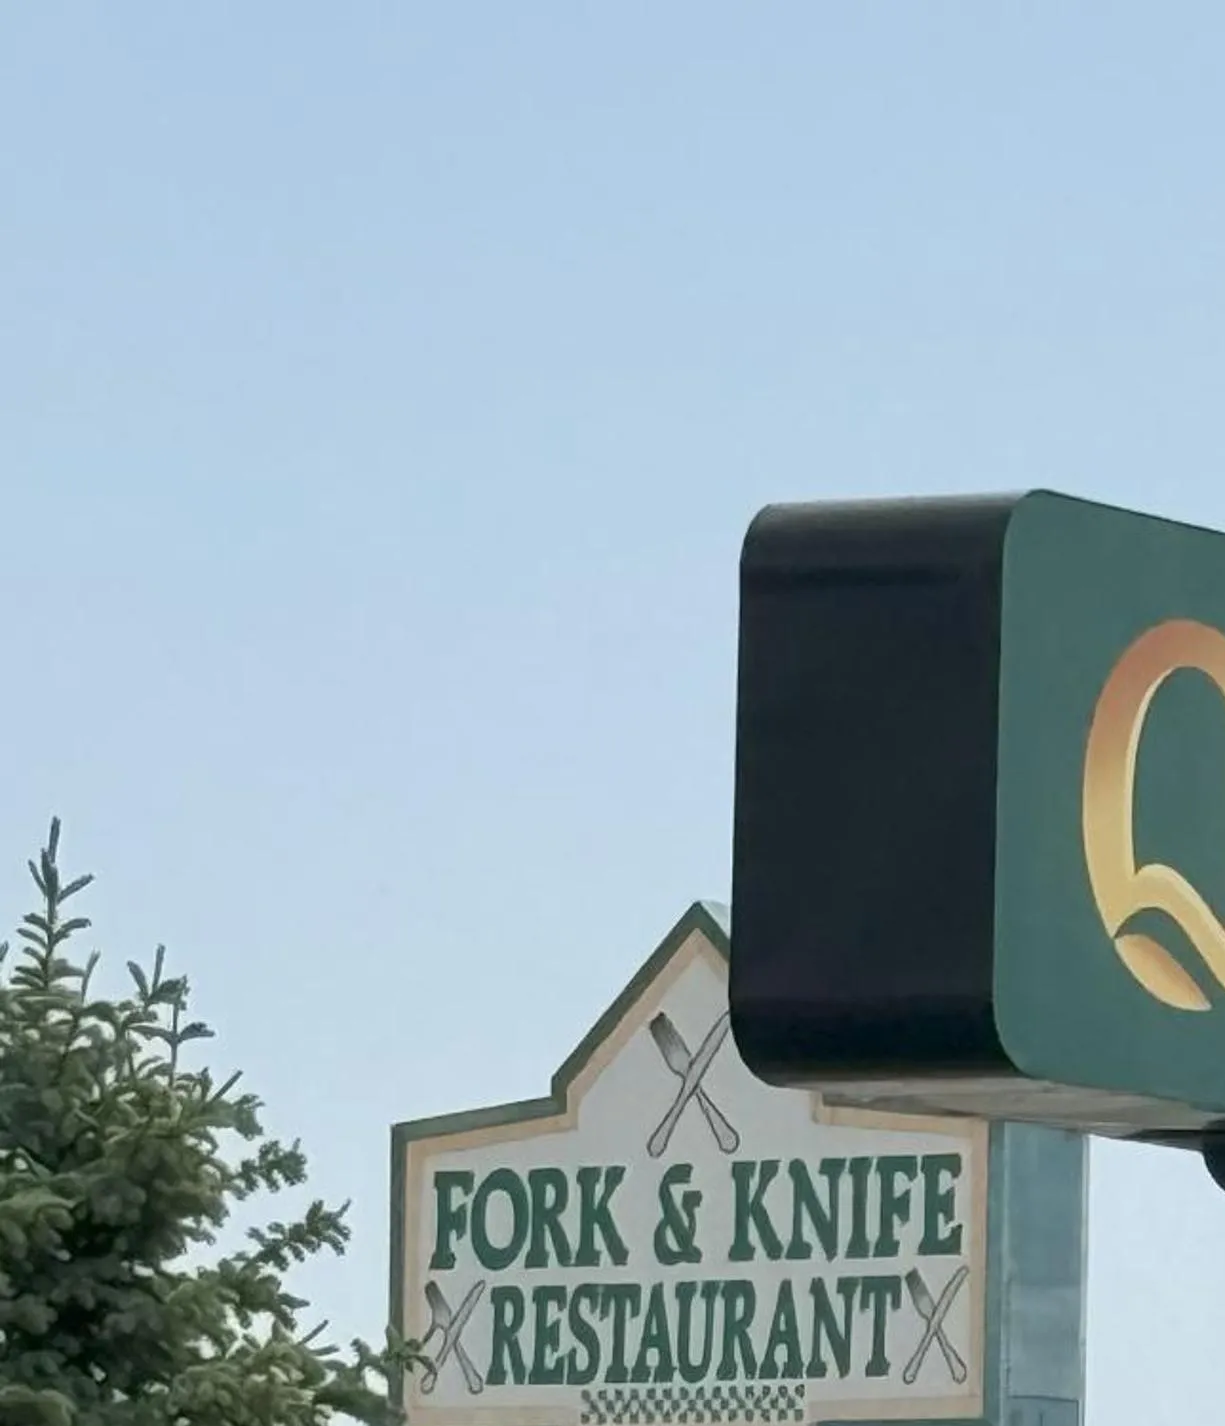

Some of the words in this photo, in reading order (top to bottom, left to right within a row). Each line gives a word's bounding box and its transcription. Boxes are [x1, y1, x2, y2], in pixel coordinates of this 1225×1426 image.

[429, 1165, 629, 1271] FORK
[653, 1162, 703, 1264] &
[728, 1152, 963, 1262] KNIFE
[485, 1274, 901, 1386] RESTAURANT
